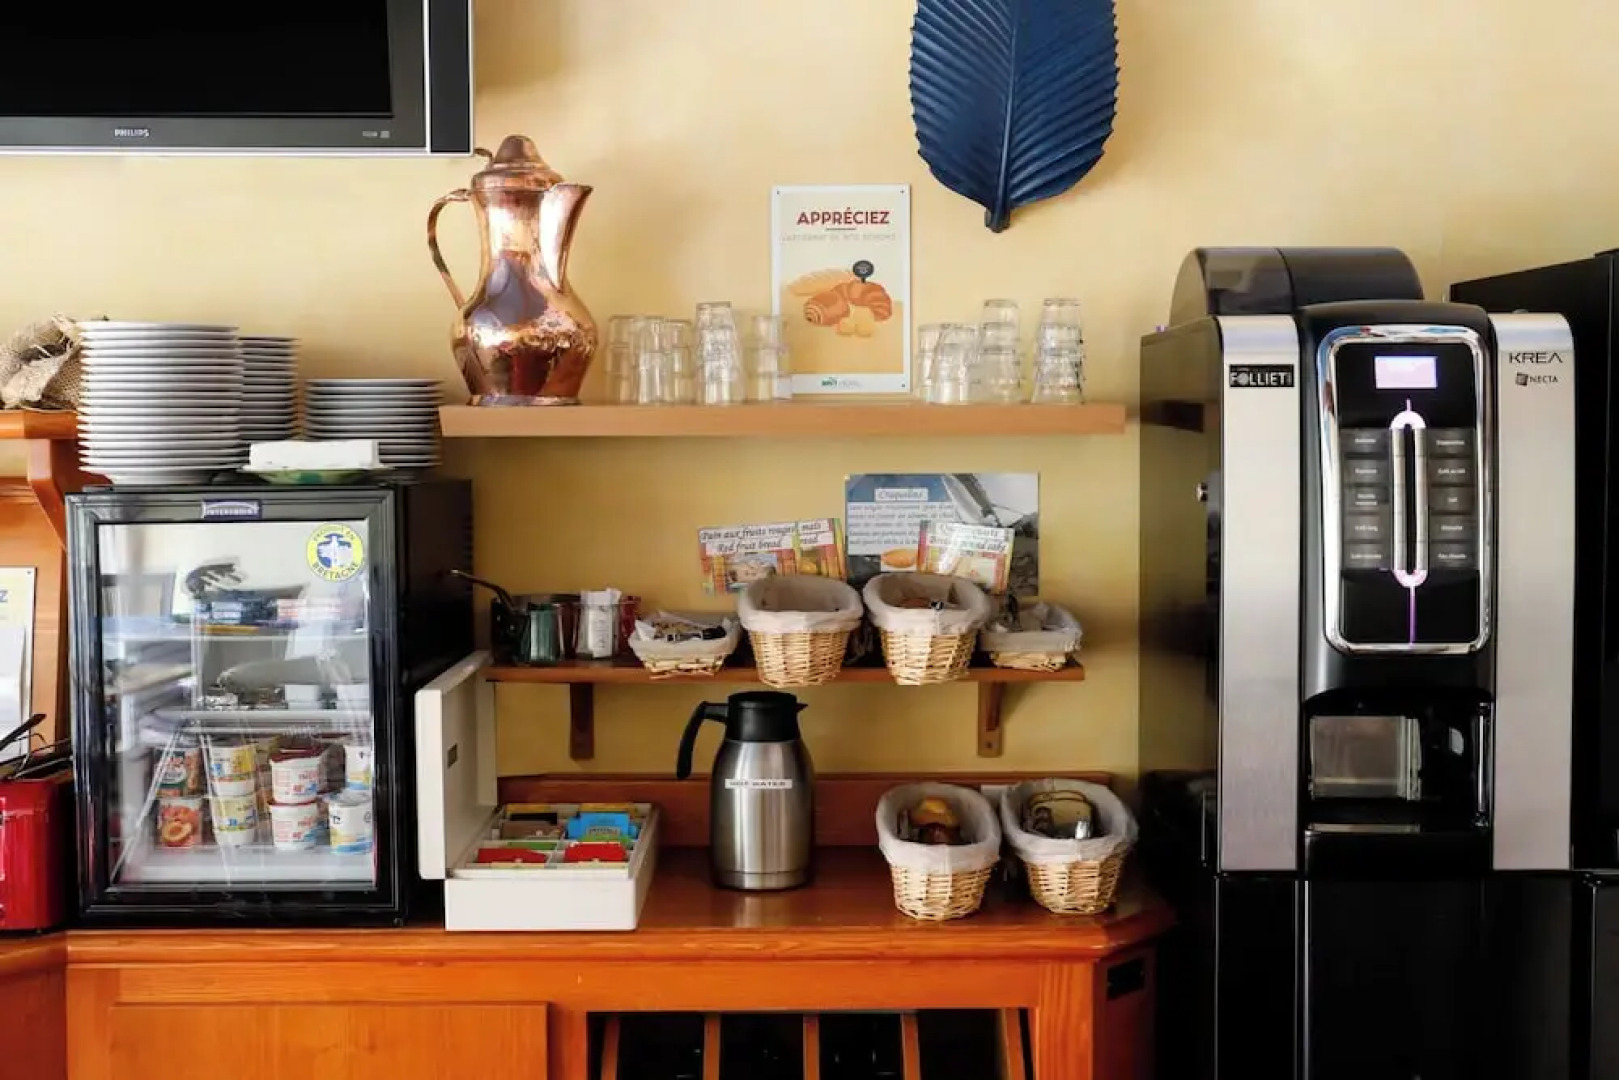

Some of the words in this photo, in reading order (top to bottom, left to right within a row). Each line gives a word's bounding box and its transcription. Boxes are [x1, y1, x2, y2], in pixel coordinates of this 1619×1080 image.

[114, 128, 150, 137] PHILIPS
[796, 206, 890, 225] APPRÉCIEZ
[1529, 375, 1558, 383] NECTA
[739, 524, 767, 540] fruits
[718, 540, 735, 552] Red
[736, 540, 757, 552] fruit
[758, 537, 782, 550] bread
[312, 561, 360, 580] BRETAGNE
